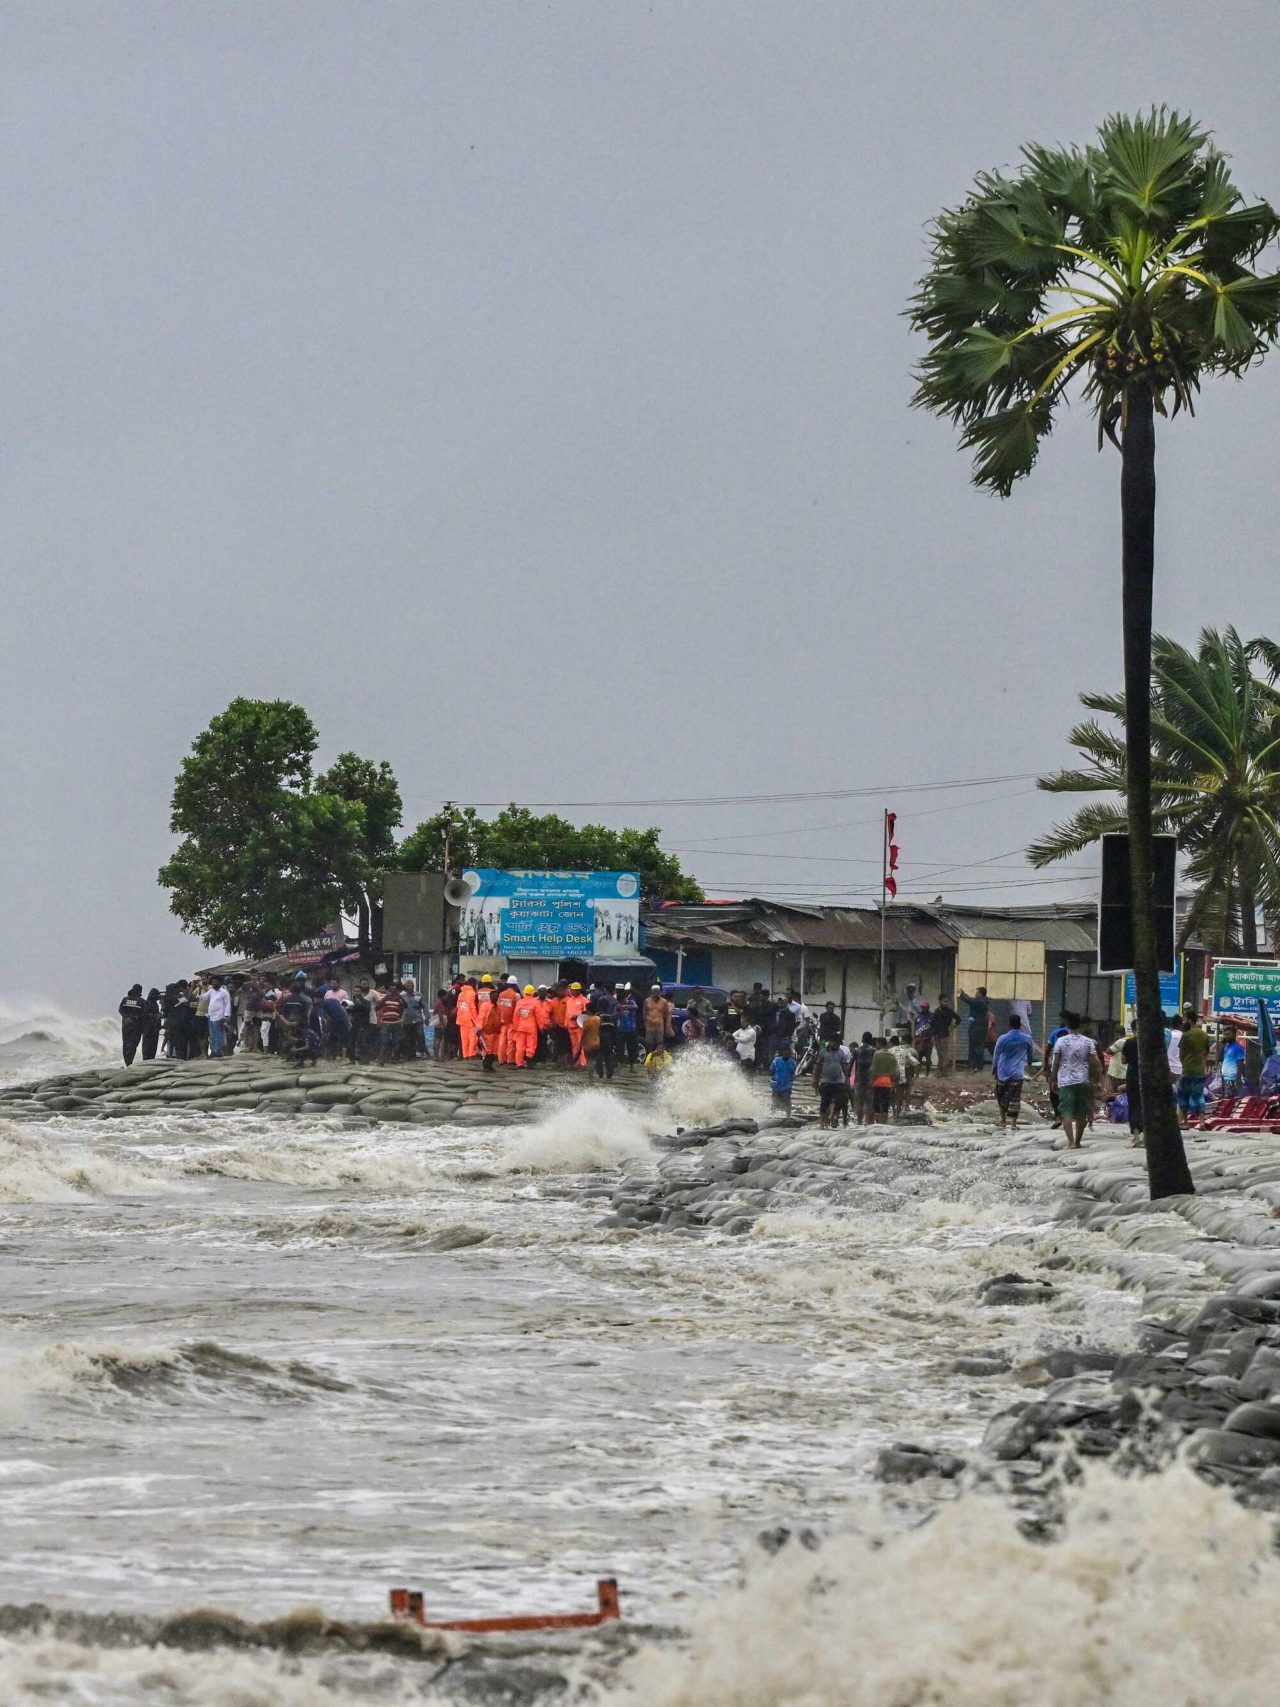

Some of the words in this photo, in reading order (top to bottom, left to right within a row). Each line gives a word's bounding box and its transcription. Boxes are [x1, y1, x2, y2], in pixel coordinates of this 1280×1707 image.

[558, 911, 584, 919] জোন
[503, 933, 535, 942] Smart
[539, 933, 563, 944] Help
[566, 933, 593, 943] Desk
